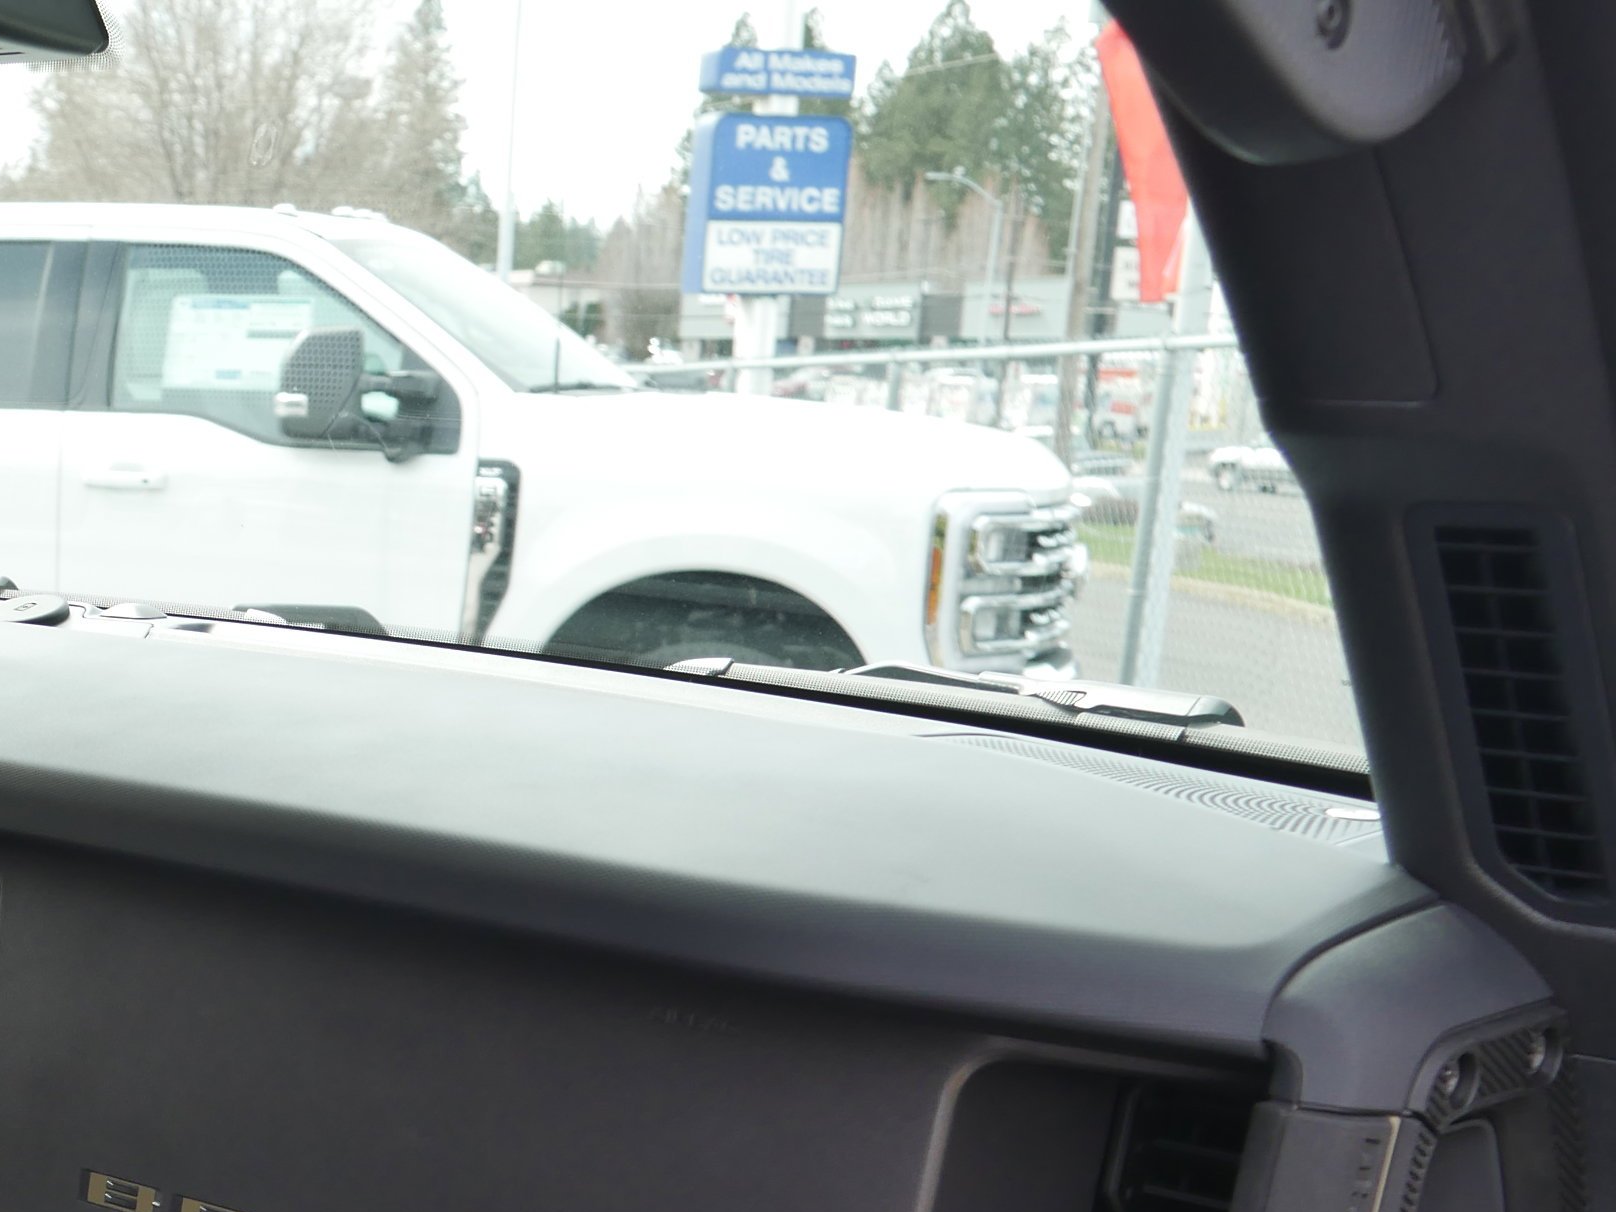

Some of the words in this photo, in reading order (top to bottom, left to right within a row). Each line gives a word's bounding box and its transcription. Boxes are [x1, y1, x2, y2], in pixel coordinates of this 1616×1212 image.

[735, 52, 765, 71] All
[768, 52, 844, 74] Makes
[721, 72, 767, 89] and
[770, 72, 851, 92] Models
[736, 123, 829, 153] PARTS
[769, 156, 789, 182] &
[714, 185, 840, 213] SERVICE
[717, 229, 764, 245] LOW
[772, 229, 830, 246] PRICE
[753, 249, 792, 265] TIRE
[711, 268, 828, 284] GUARANTEE
